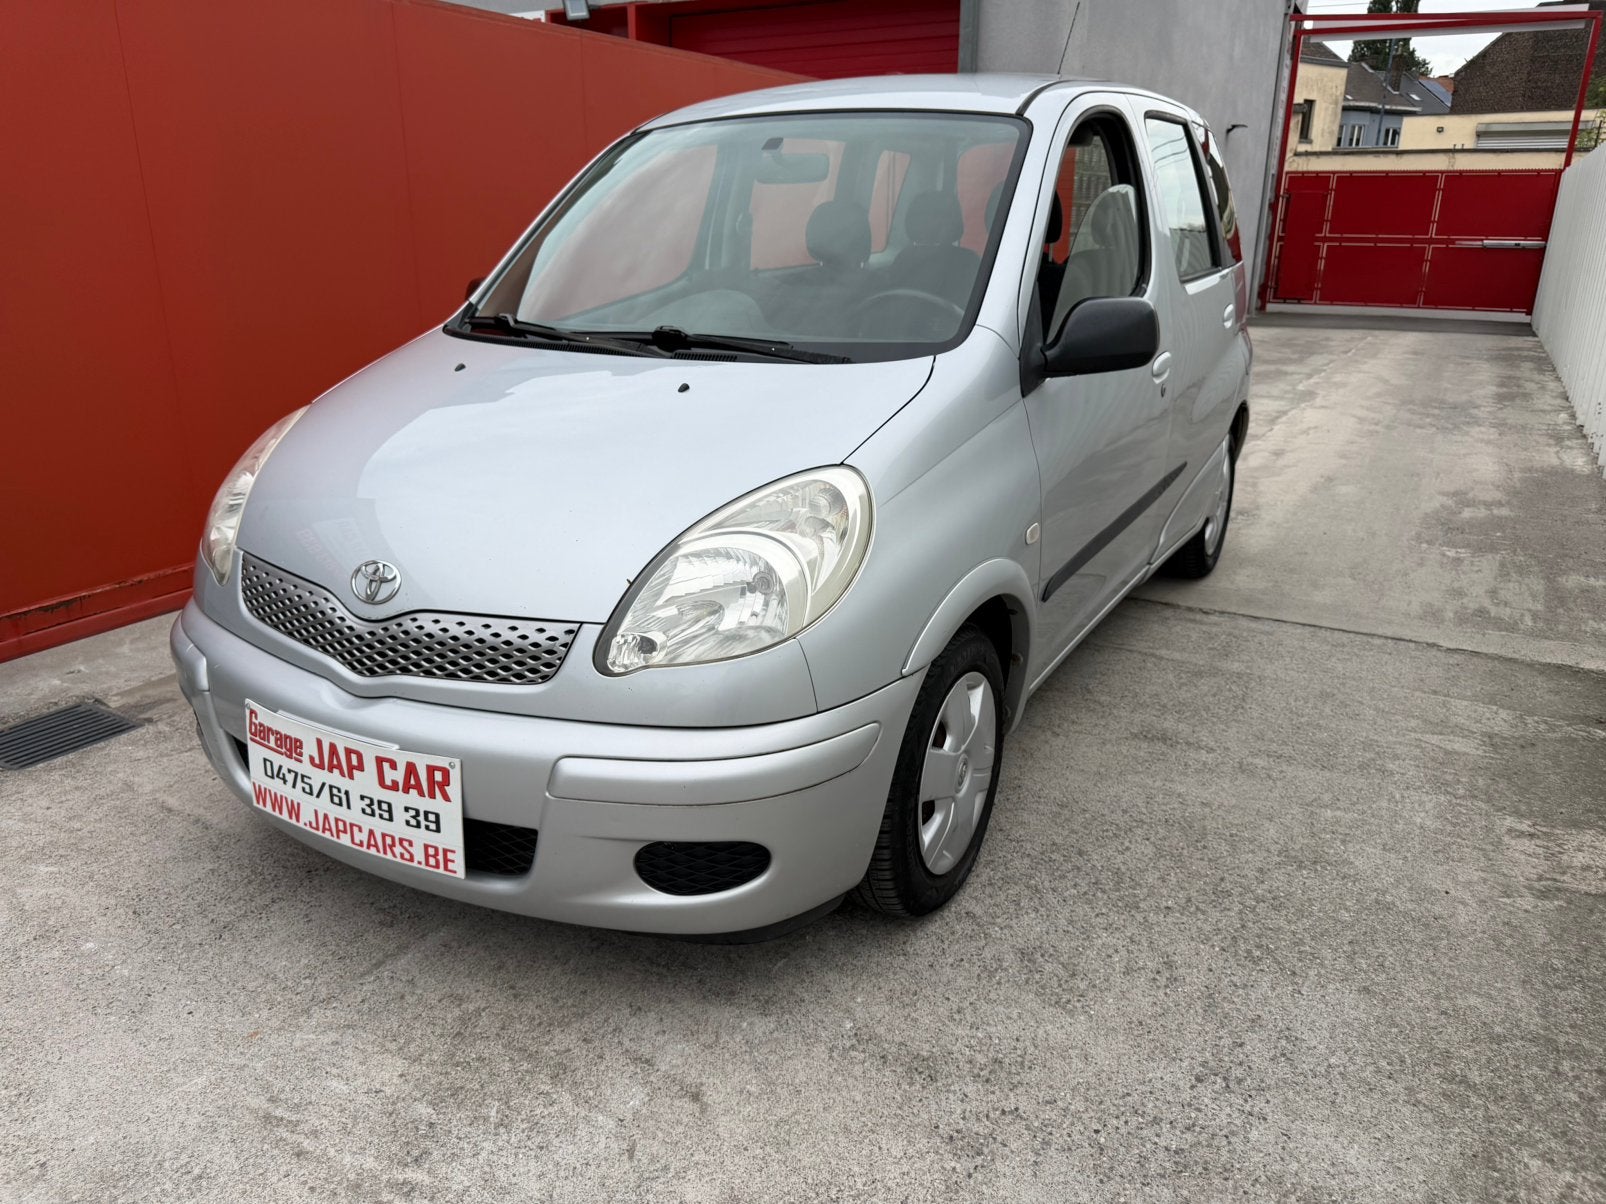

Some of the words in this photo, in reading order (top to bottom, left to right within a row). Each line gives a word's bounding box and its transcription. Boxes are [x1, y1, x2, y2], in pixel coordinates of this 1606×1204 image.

[249, 708, 303, 761] Garage
[309, 737, 365, 780] JAP
[375, 756, 452, 802] CAR
[263, 757, 351, 810] 0475/61
[360, 794, 394, 822] 39
[404, 805, 441, 833] 39
[252, 781, 457, 874] WWW.JAPCARS.BE
